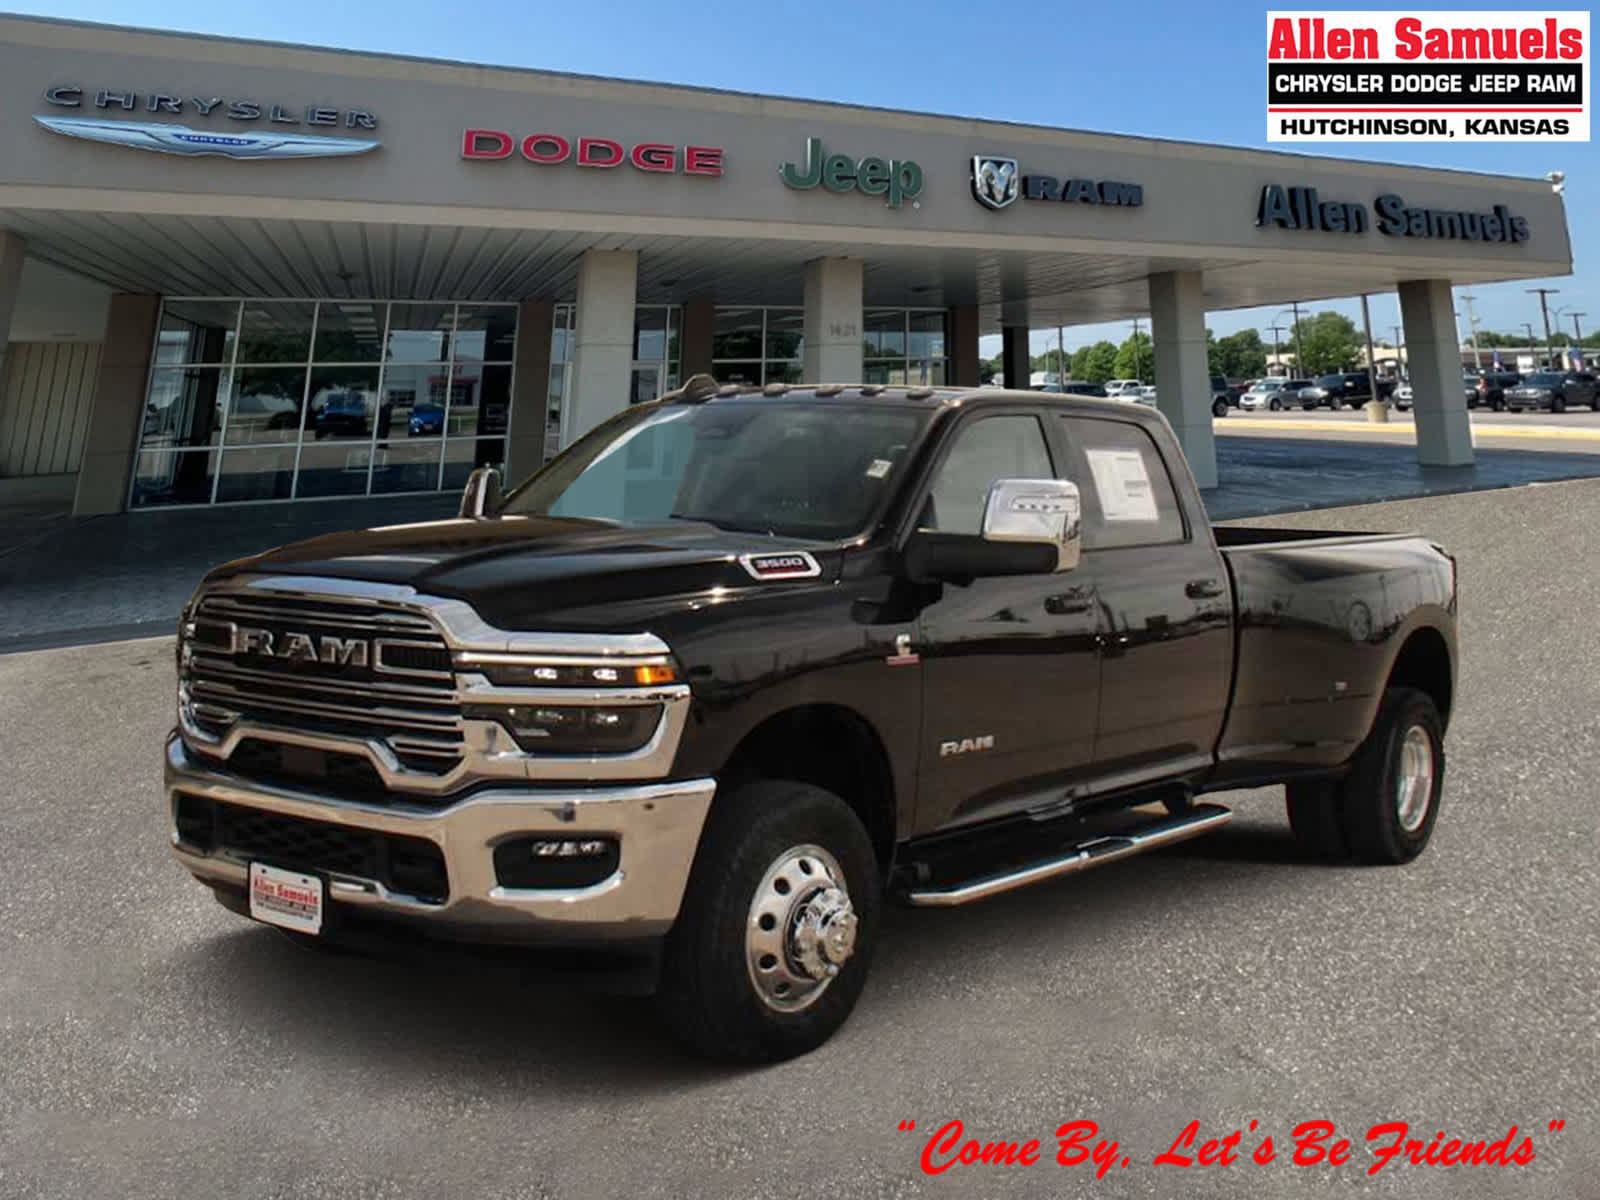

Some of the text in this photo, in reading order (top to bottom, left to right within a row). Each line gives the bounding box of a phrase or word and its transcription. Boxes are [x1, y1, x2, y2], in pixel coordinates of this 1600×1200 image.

[45, 86, 377, 129] CHRYSLER
[462, 128, 724, 177] DODGE
[779, 136, 924, 209] Jeep
[1022, 175, 1143, 207] RAM
[1256, 184, 1530, 243] Allen Samuels
[755, 557, 803, 569] 3500
[238, 627, 369, 667] RAM
[940, 735, 994, 756] RAM
